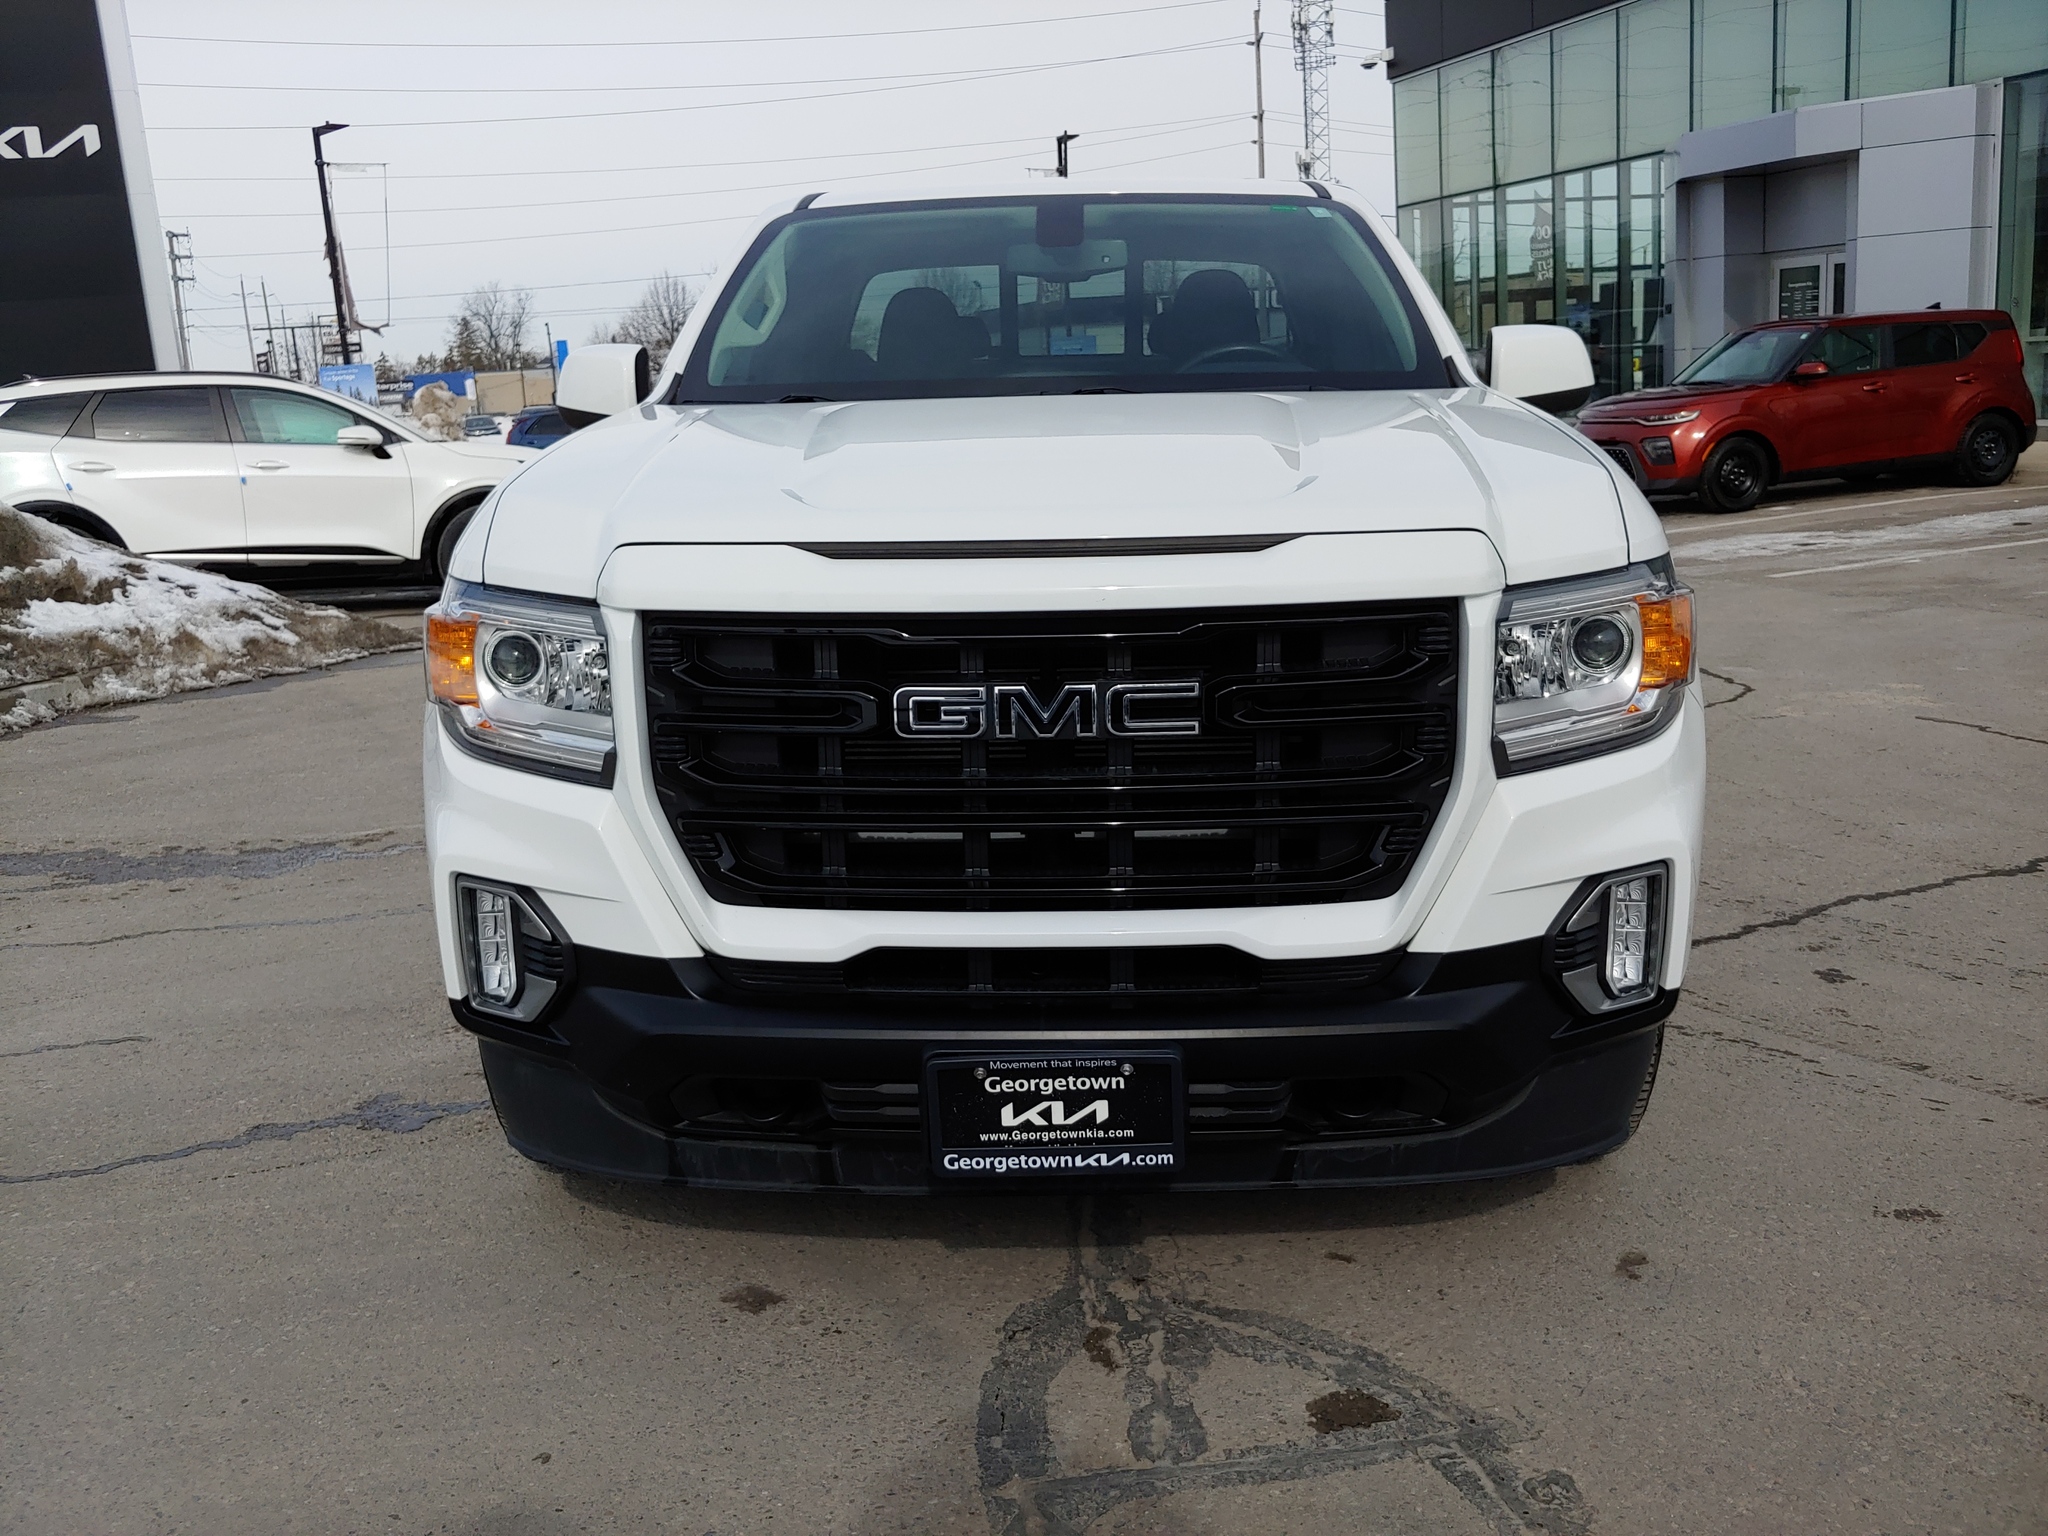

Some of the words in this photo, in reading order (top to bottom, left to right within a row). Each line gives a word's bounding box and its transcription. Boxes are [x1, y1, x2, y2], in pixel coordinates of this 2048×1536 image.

[893, 682, 1199, 738] GMC
[989, 1060, 1048, 1070] Movement
[1050, 1059, 1073, 1068] that
[1075, 1058, 1117, 1069] inspires
[984, 1076, 1125, 1095] Georgetown
[1001, 1099, 1109, 1127] KIA
[979, 1127, 1134, 1142] www.Georgetownkia.com
